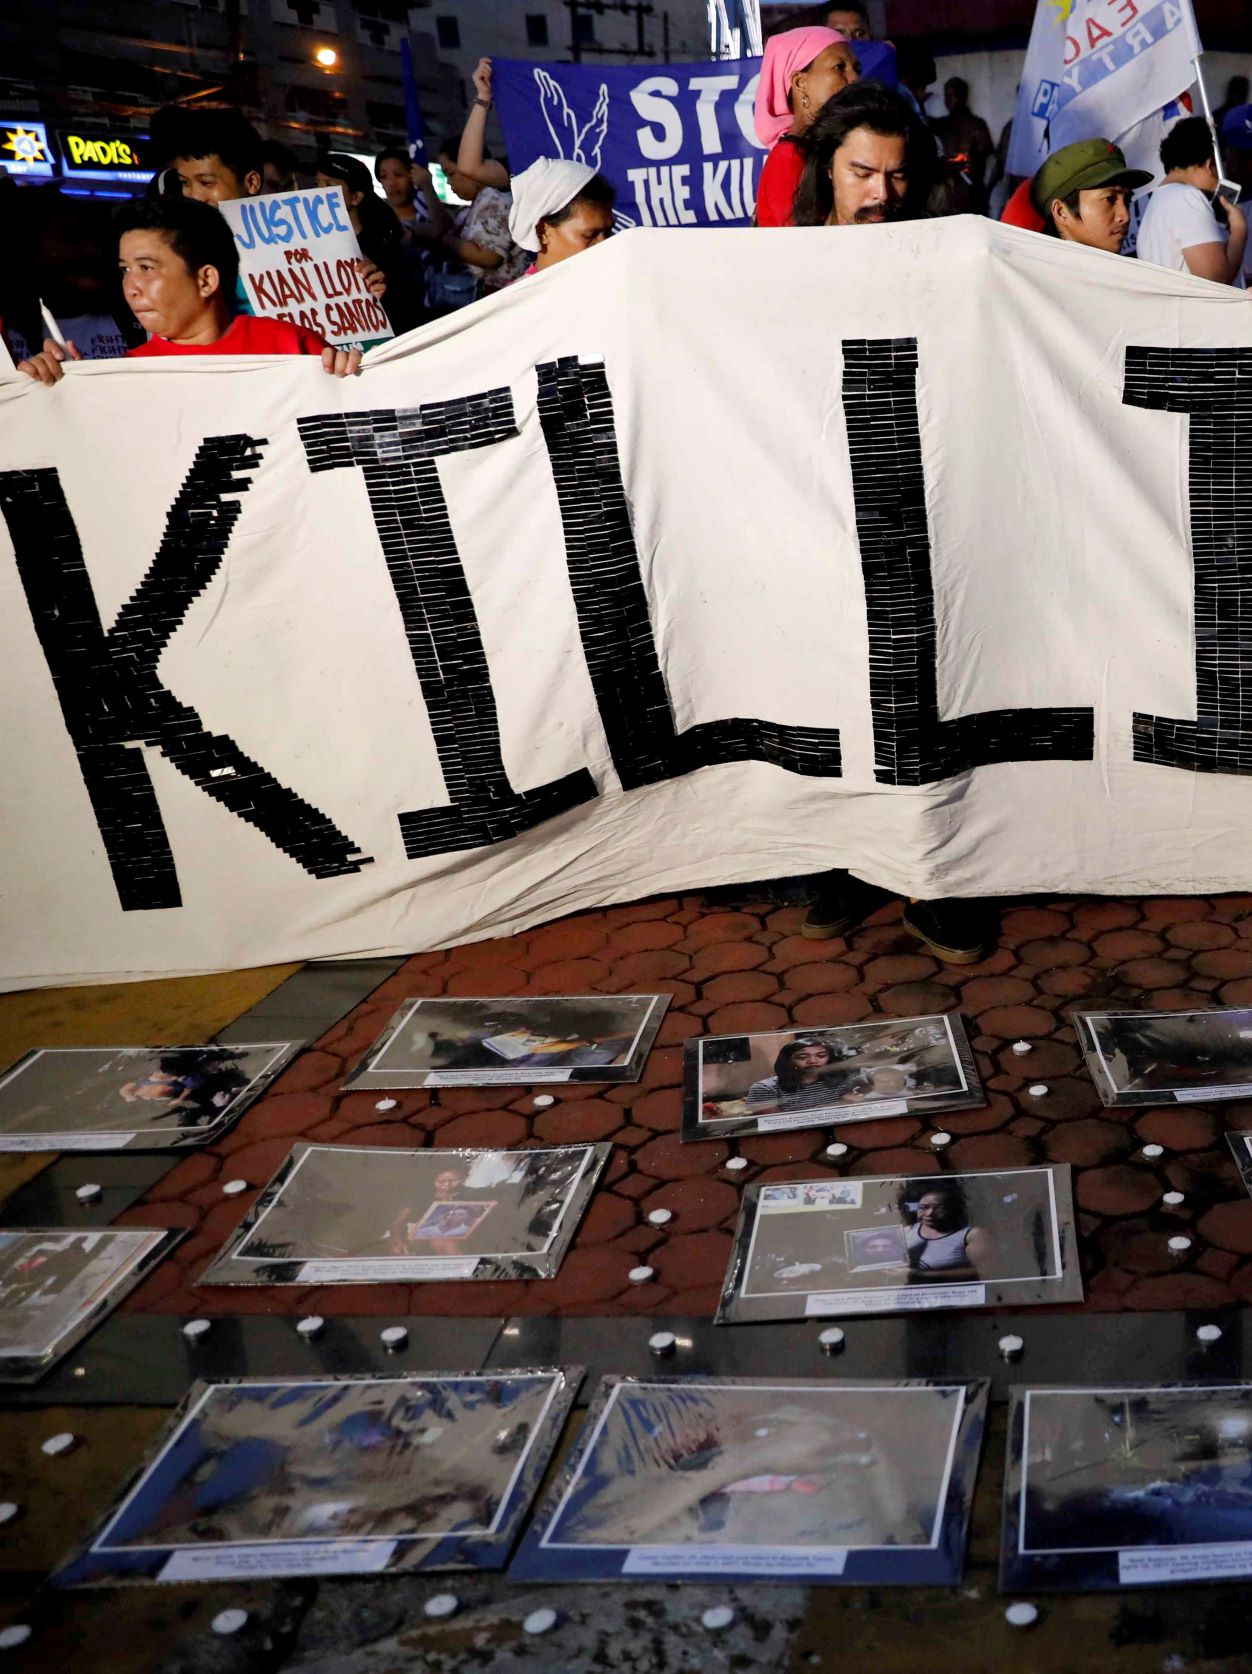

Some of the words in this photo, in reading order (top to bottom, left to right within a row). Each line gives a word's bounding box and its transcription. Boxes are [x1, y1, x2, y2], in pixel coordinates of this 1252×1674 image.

[67, 135, 132, 165] PADI'S
[235, 191, 349, 249] JUSTICE
[627, 164, 697, 227] THE
[248, 265, 318, 311] KIAN
[314, 257, 373, 299] LLOY
[324, 296, 388, 336] SANTOS
